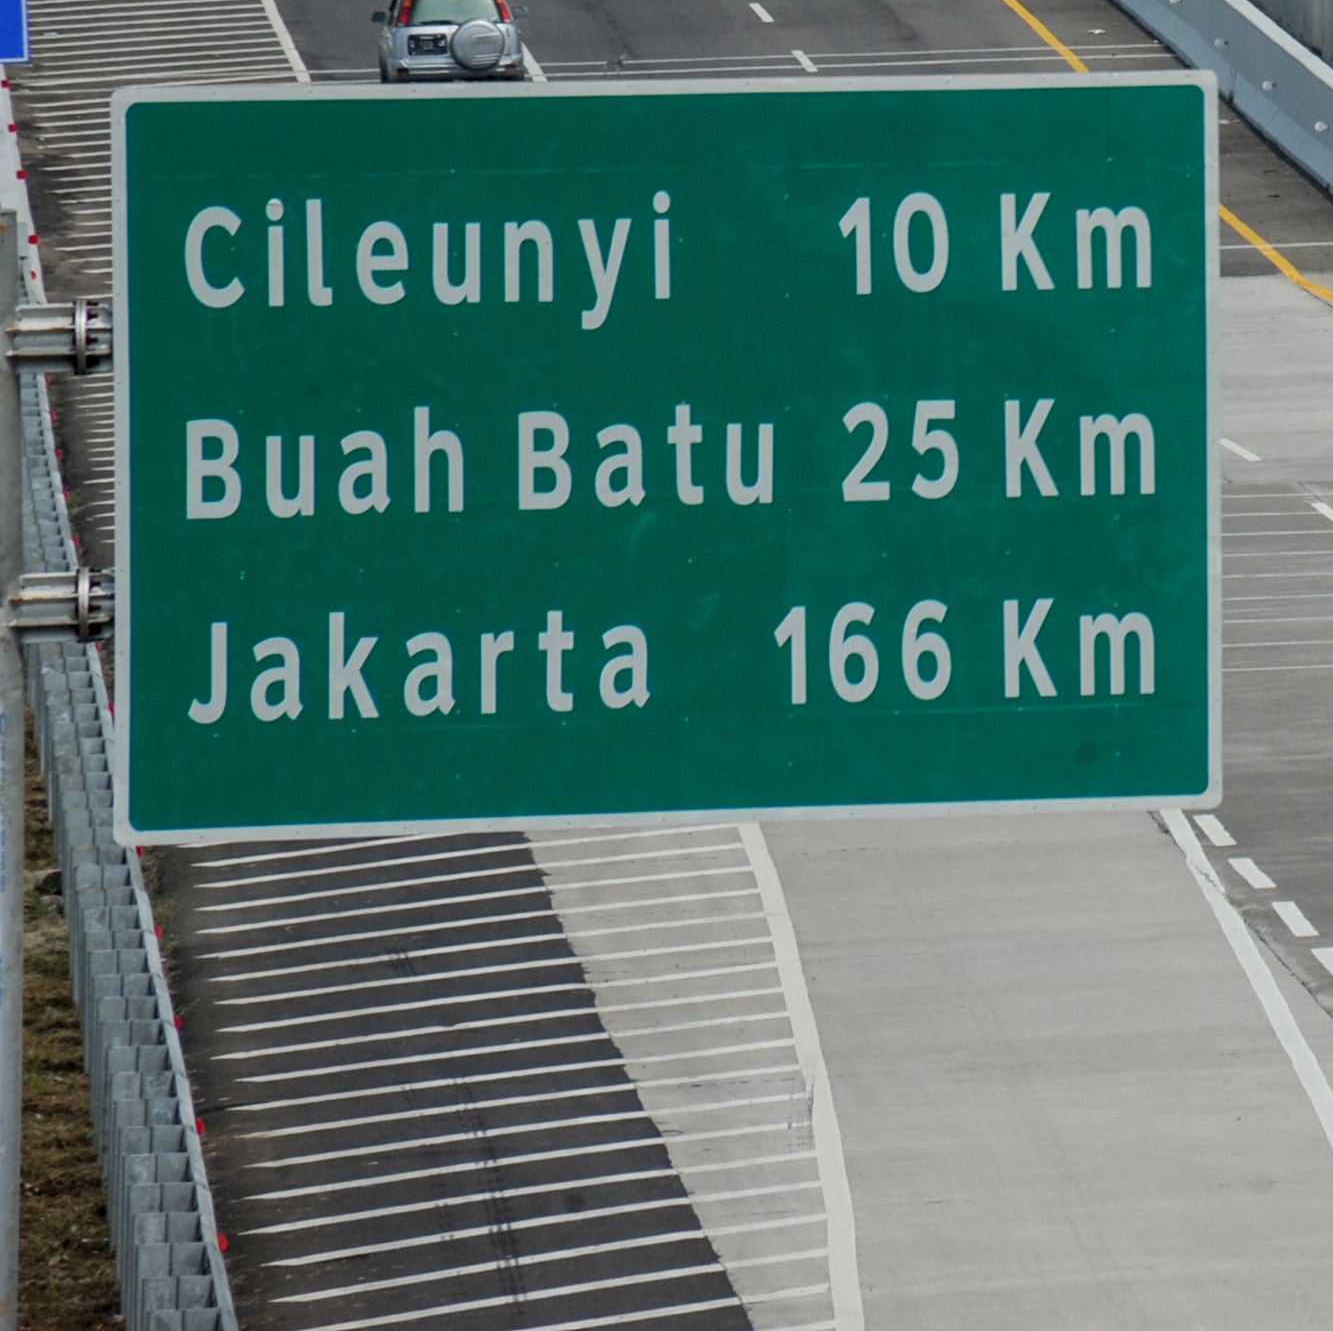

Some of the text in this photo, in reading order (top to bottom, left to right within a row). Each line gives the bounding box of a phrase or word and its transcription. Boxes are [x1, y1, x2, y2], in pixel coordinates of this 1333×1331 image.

[184, 190, 1152, 331] Cileunyi 10 Km
[186, 398, 1156, 520] Buah Batu 25 Km
[188, 598, 1156, 725] Jakarta 166 Km
